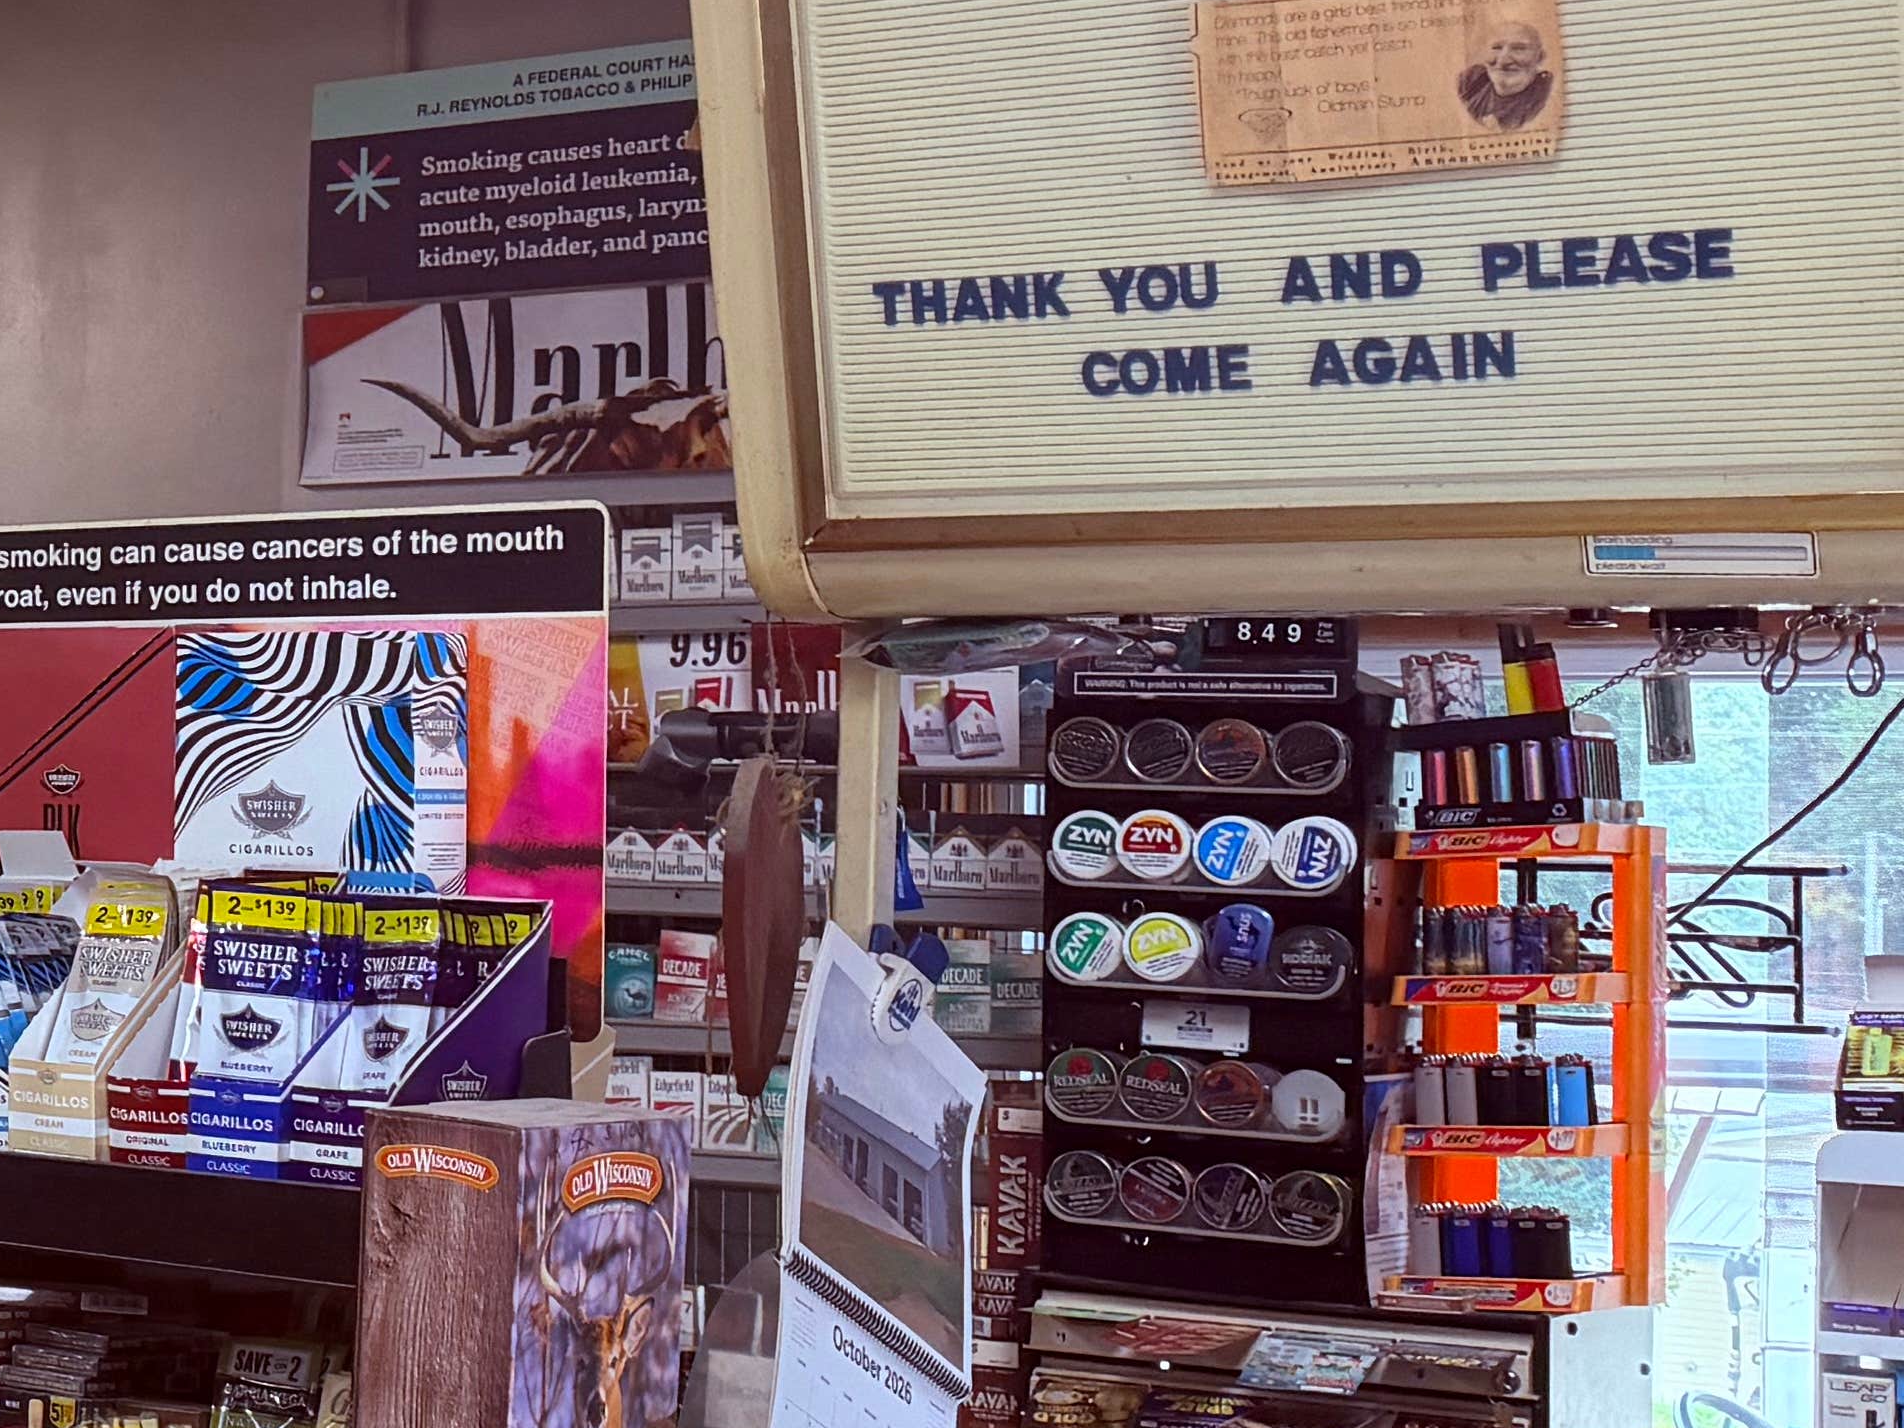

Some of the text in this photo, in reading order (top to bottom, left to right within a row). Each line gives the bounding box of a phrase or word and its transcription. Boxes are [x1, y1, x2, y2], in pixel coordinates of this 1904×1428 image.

[528, 58, 663, 87] FEDERAL COURT
[450, 92, 534, 114] REYNOLDS
[540, 82, 620, 104] TOBACCO
[422, 133, 670, 177] Smoking causes heart
[420, 184, 480, 207] acute
[486, 172, 576, 203] myeloid
[506, 200, 633, 233] esophagus,
[418, 231, 646, 269] kidney, bladder, and
[873, 228, 1735, 327] THANK YOU AND PLEASE
[1083, 331, 1517, 396] COME AGAIN
[110, 543, 155, 564] can
[164, 538, 244, 563] cause
[252, 533, 363, 560] cancers
[372, 530, 400, 556] of
[409, 530, 457, 554] the
[467, 524, 564, 553] mouth
[56, 585, 116, 605] even
[125, 580, 142, 605] if
[149, 584, 197, 610] you
[206, 578, 240, 603] do
[249, 577, 294, 601] not
[303, 574, 396, 600] inhale.
[229, 842, 313, 858] CIGARILLOS
[1129, 827, 1174, 844] ZYN
[214, 939, 299, 962] SWISHER
[218, 958, 292, 980] SWEETS
[387, 1147, 487, 1182] OLD WISCONSIN
[998, 1154, 1028, 1255] KAYAK
[832, 1325, 882, 1383] October
